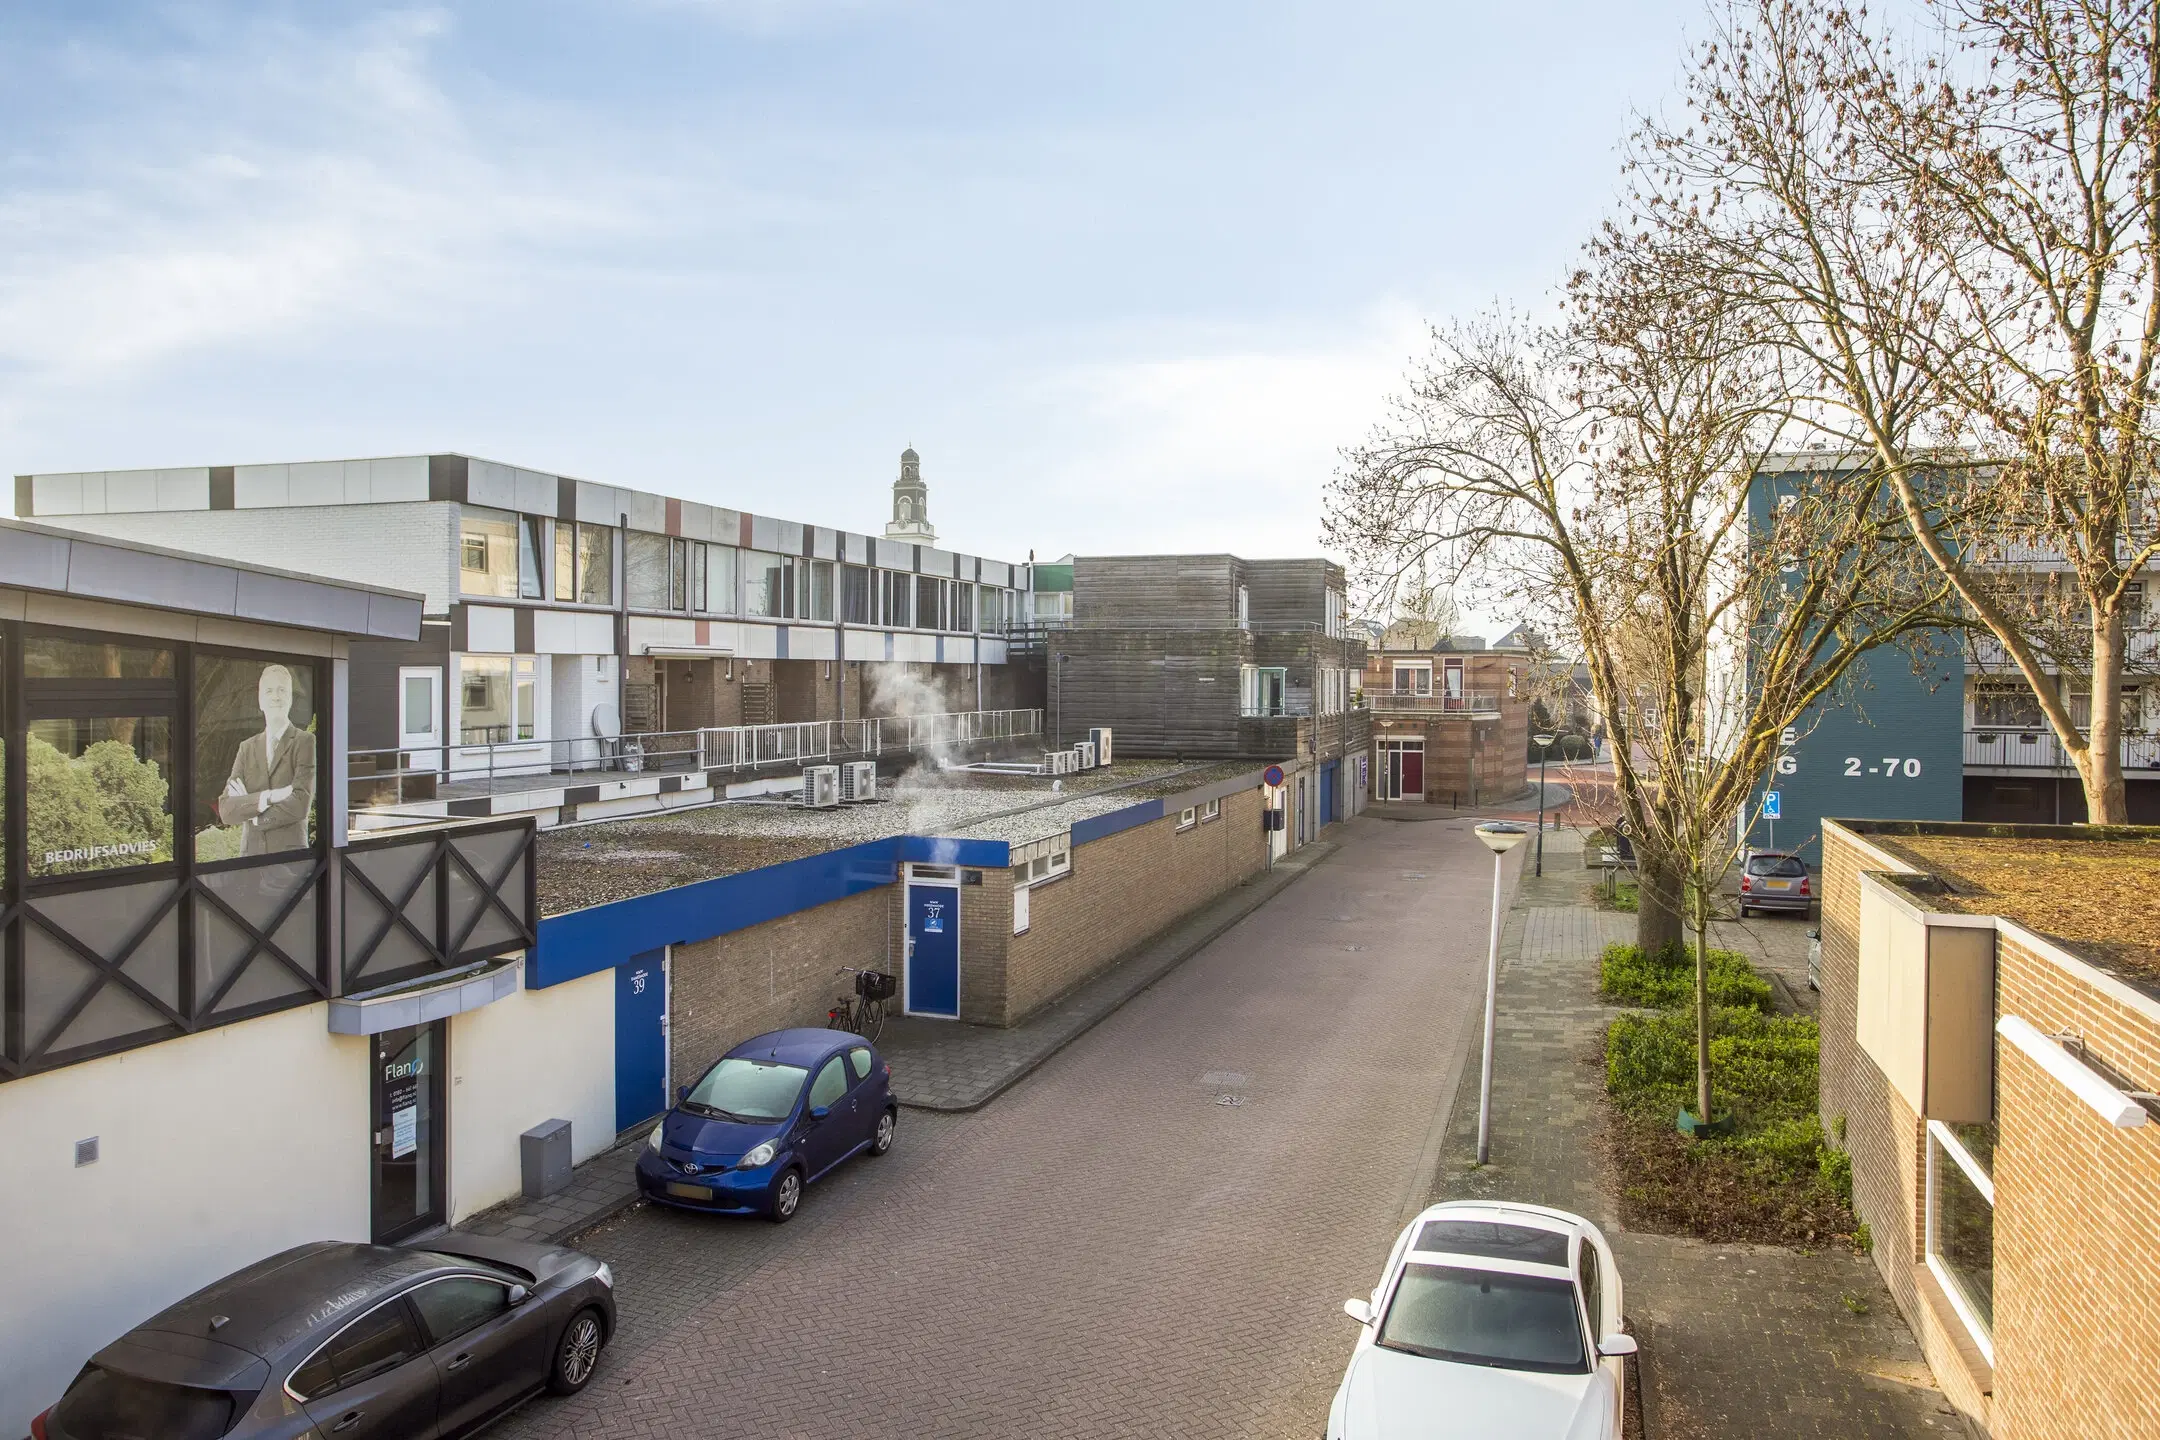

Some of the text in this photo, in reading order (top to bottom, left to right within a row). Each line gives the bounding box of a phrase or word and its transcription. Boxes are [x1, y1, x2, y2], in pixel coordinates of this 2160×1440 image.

[1766, 793, 1776, 806] P
[45, 839, 156, 864] BEDRIJFSADVIES
[928, 907, 940, 918] 37
[633, 978, 645, 994] 39
